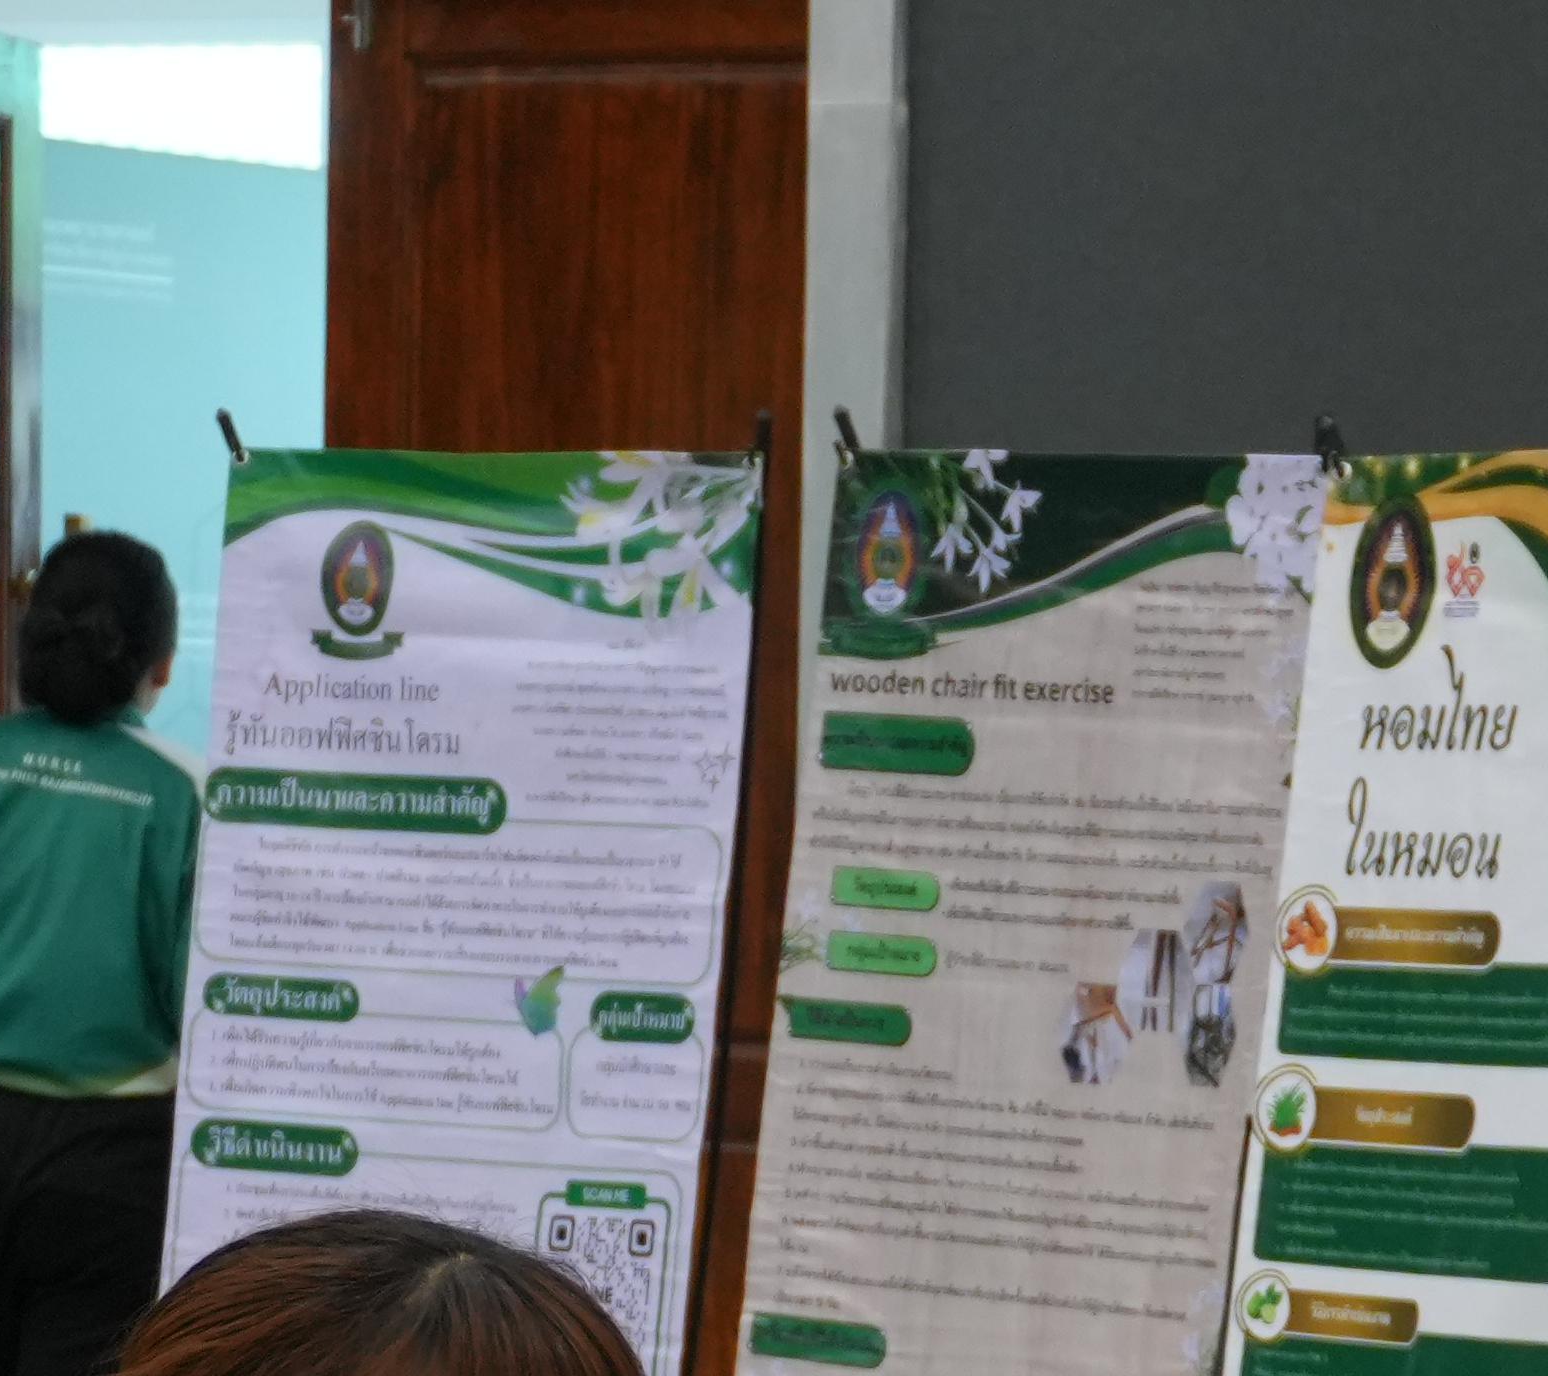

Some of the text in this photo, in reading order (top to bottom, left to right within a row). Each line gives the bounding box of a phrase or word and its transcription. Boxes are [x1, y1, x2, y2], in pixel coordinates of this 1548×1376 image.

[264, 671, 441, 705] Application line
[830, 669, 1115, 704] wooden chair fit exercise
[1359, 644, 1518, 751] หอมไทย
[1345, 776, 1502, 879] ในหมอน
